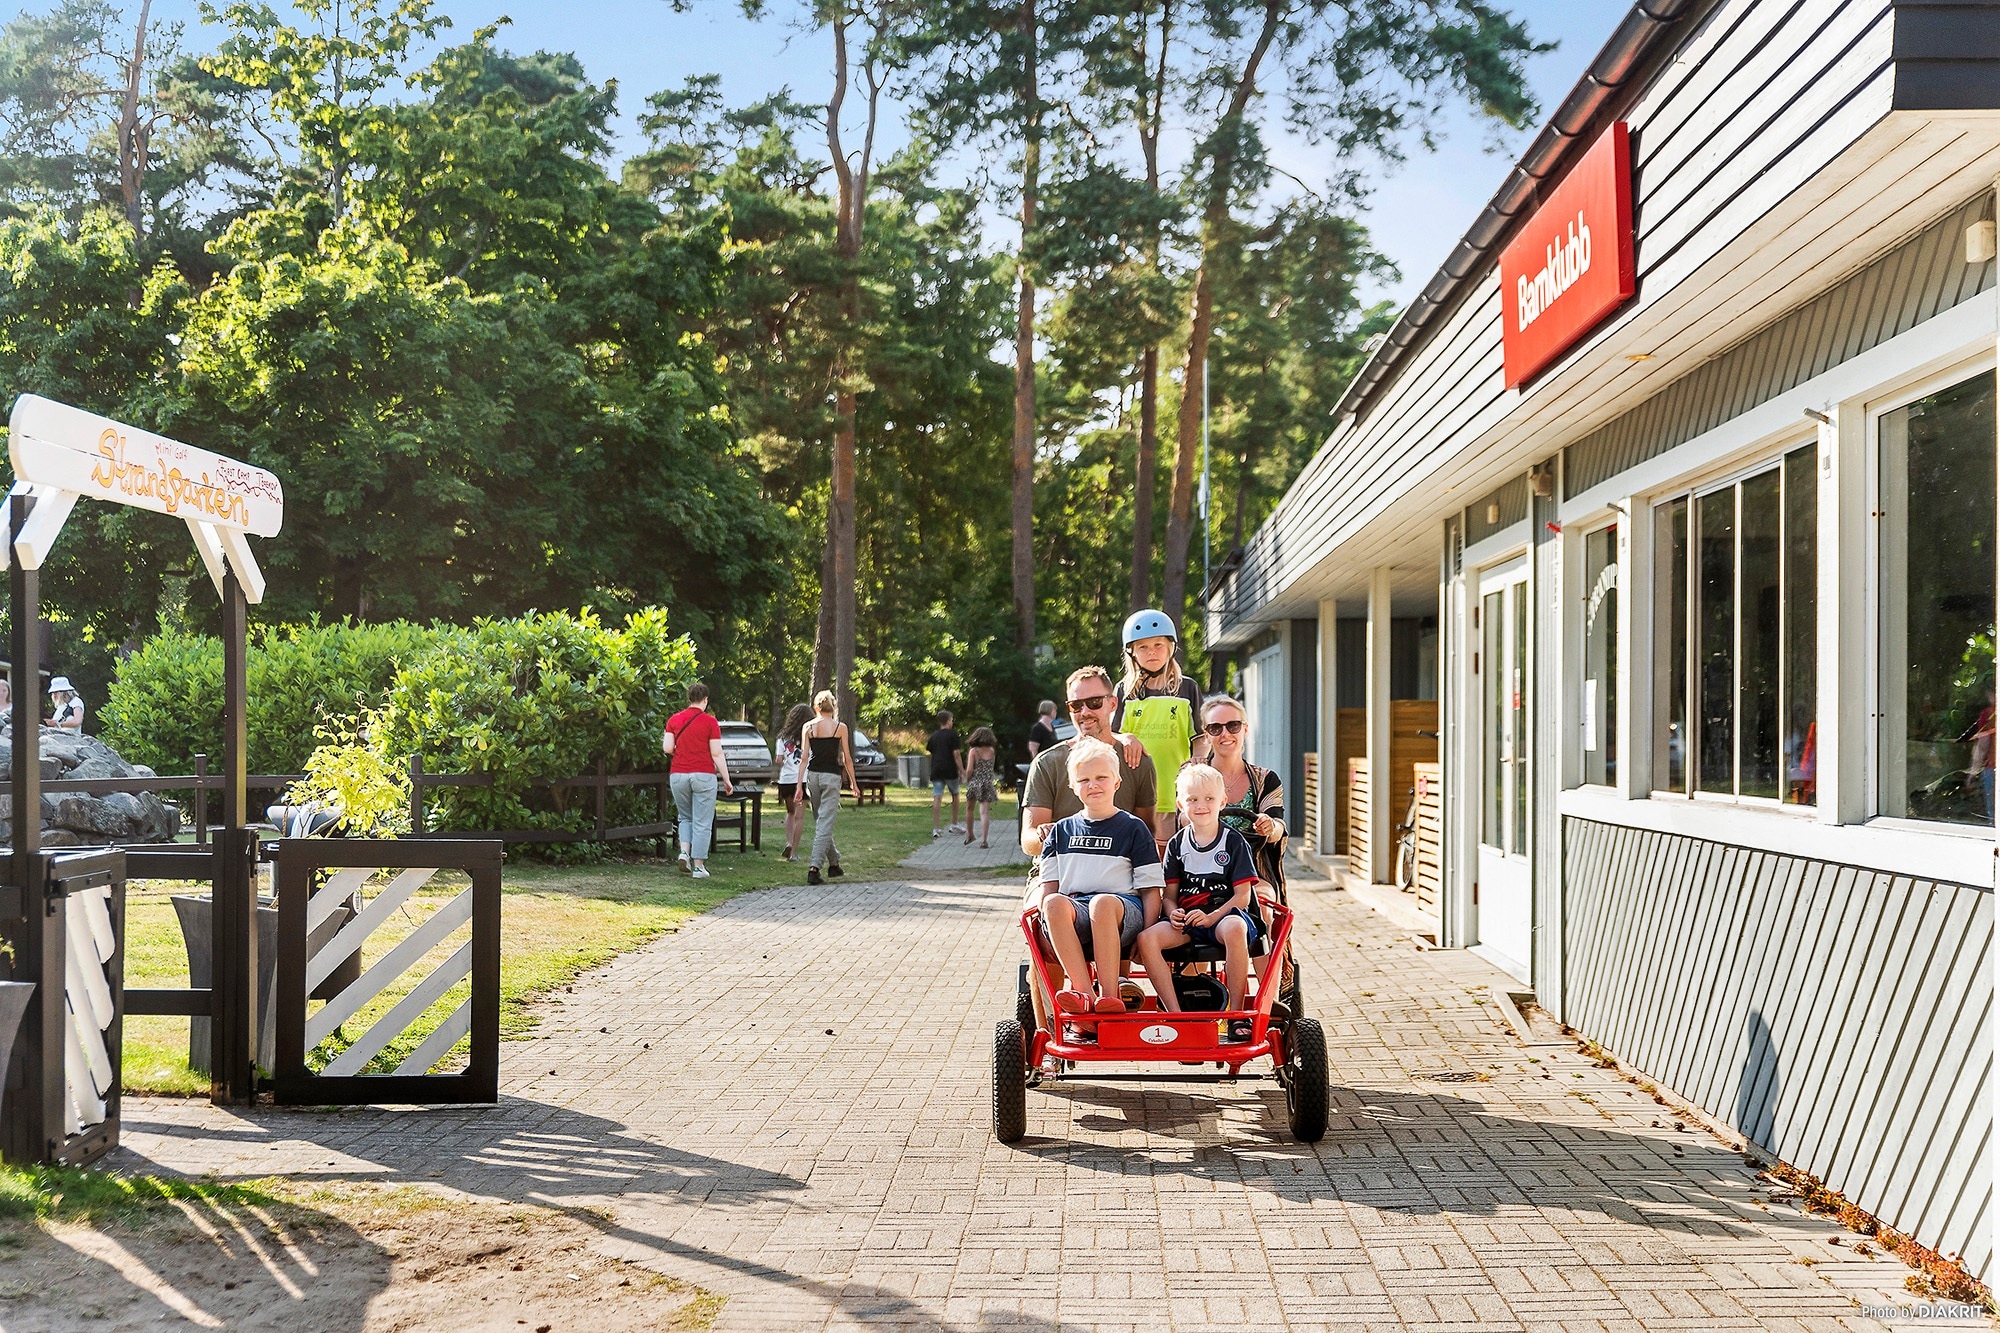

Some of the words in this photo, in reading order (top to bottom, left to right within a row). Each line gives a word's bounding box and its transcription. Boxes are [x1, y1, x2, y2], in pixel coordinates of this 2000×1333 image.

[1517, 210, 1592, 334] Barnklubb
[155, 442, 172, 456] Mini
[1094, 838, 1110, 848] AIR
[1155, 1027, 1162, 1038] 1
